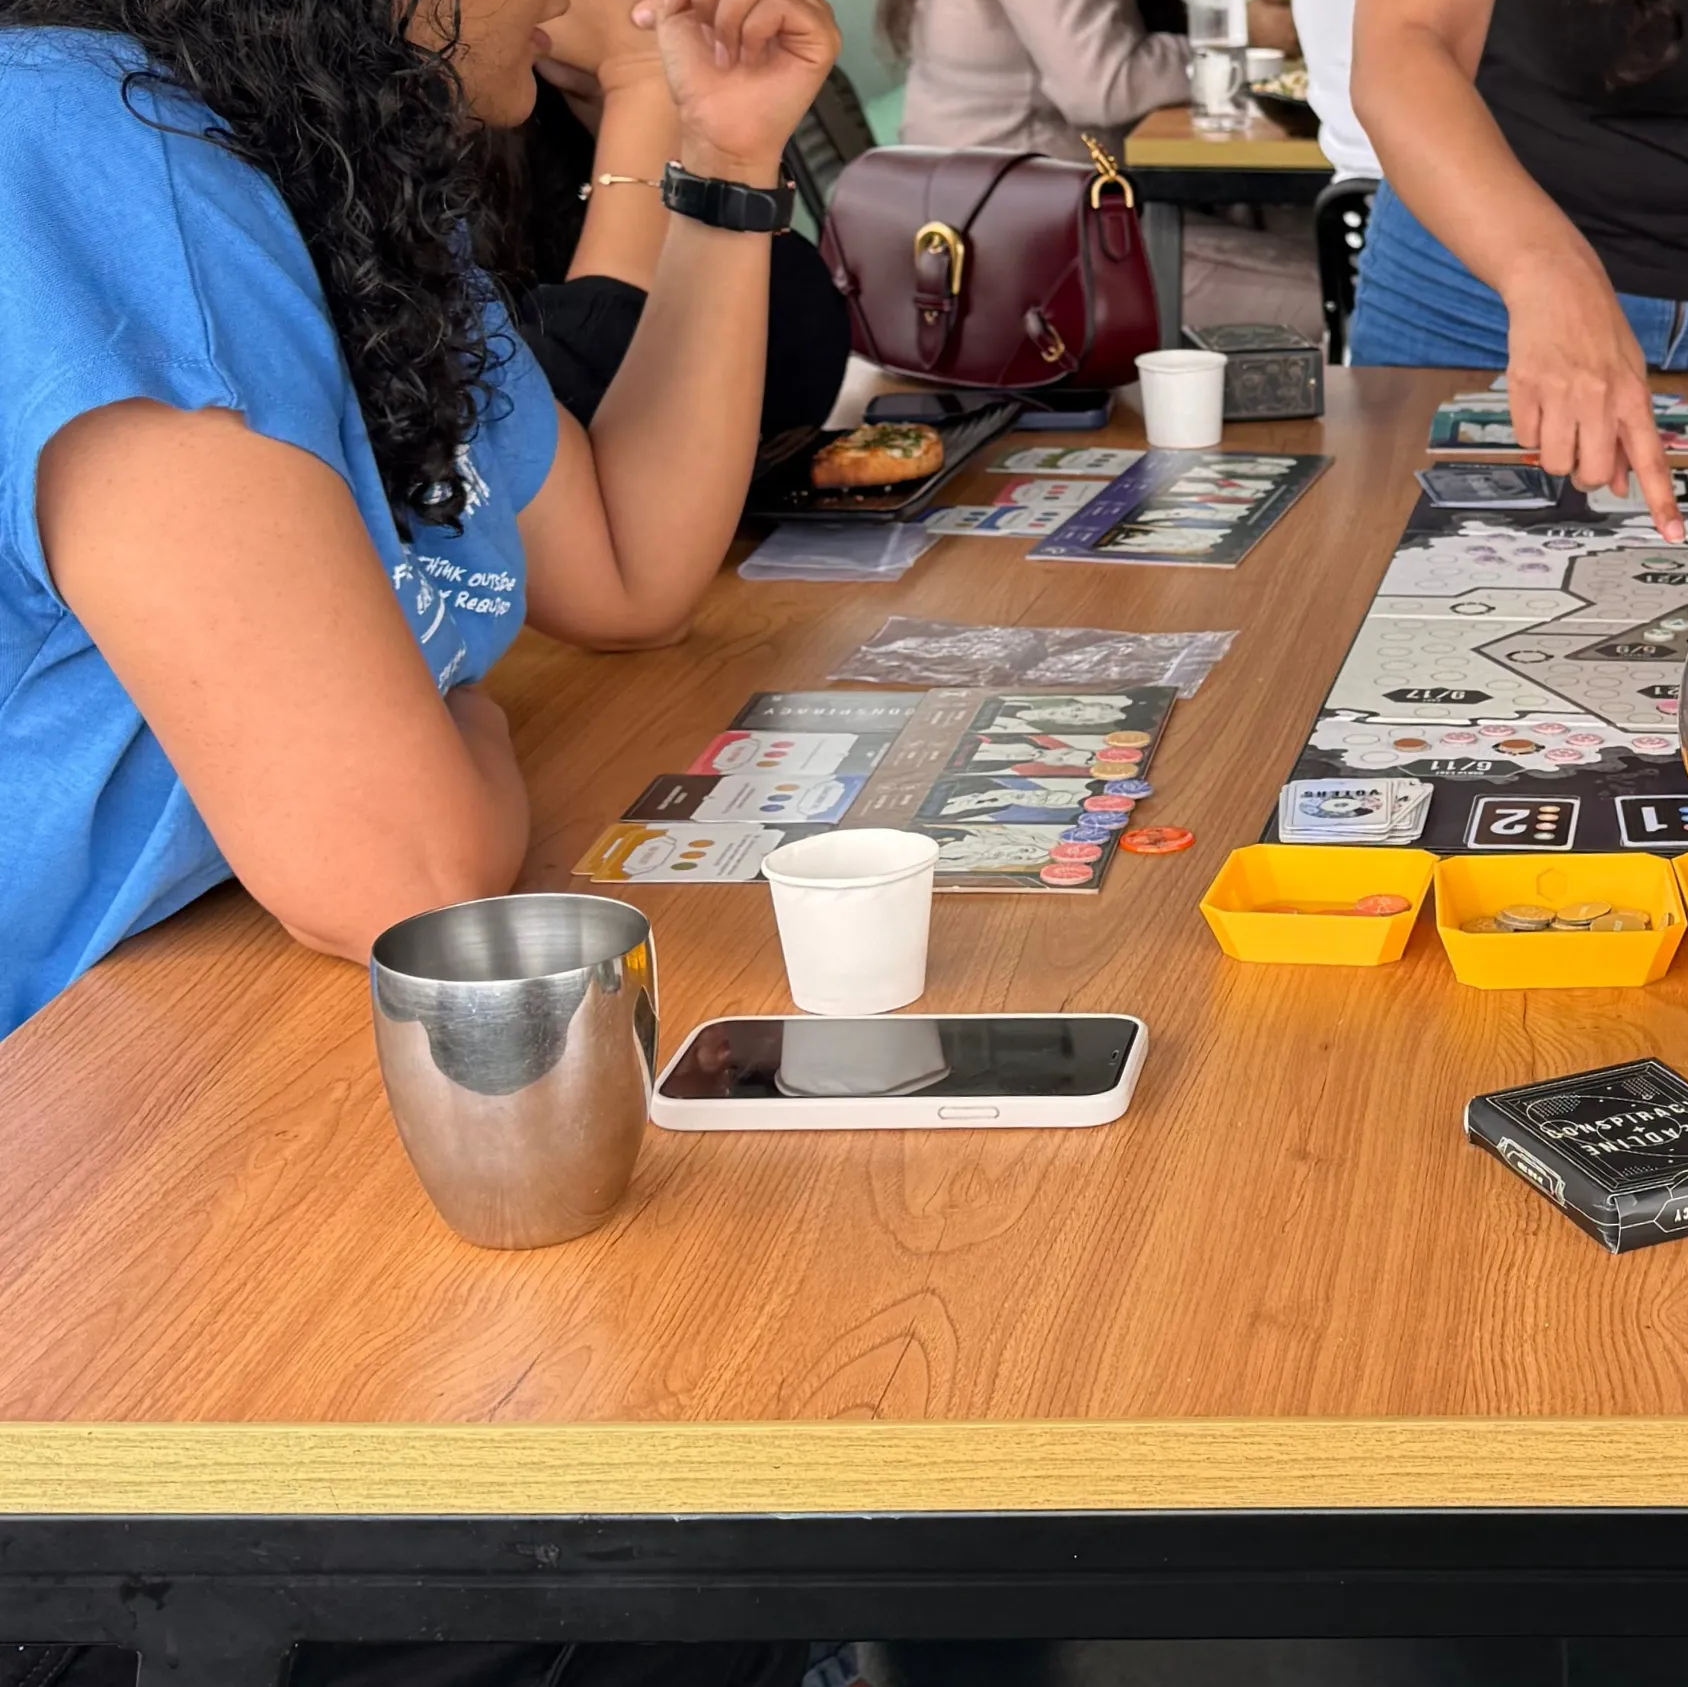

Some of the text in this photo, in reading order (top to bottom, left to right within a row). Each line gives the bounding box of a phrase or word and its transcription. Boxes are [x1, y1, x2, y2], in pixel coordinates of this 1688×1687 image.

[1406, 689, 1466, 701] 9/17
[1430, 759, 1493, 772] 6/11
[1303, 788, 1380, 799] VOTERS
[1489, 808, 1532, 834] 2
[1640, 806, 1669, 832] 1
